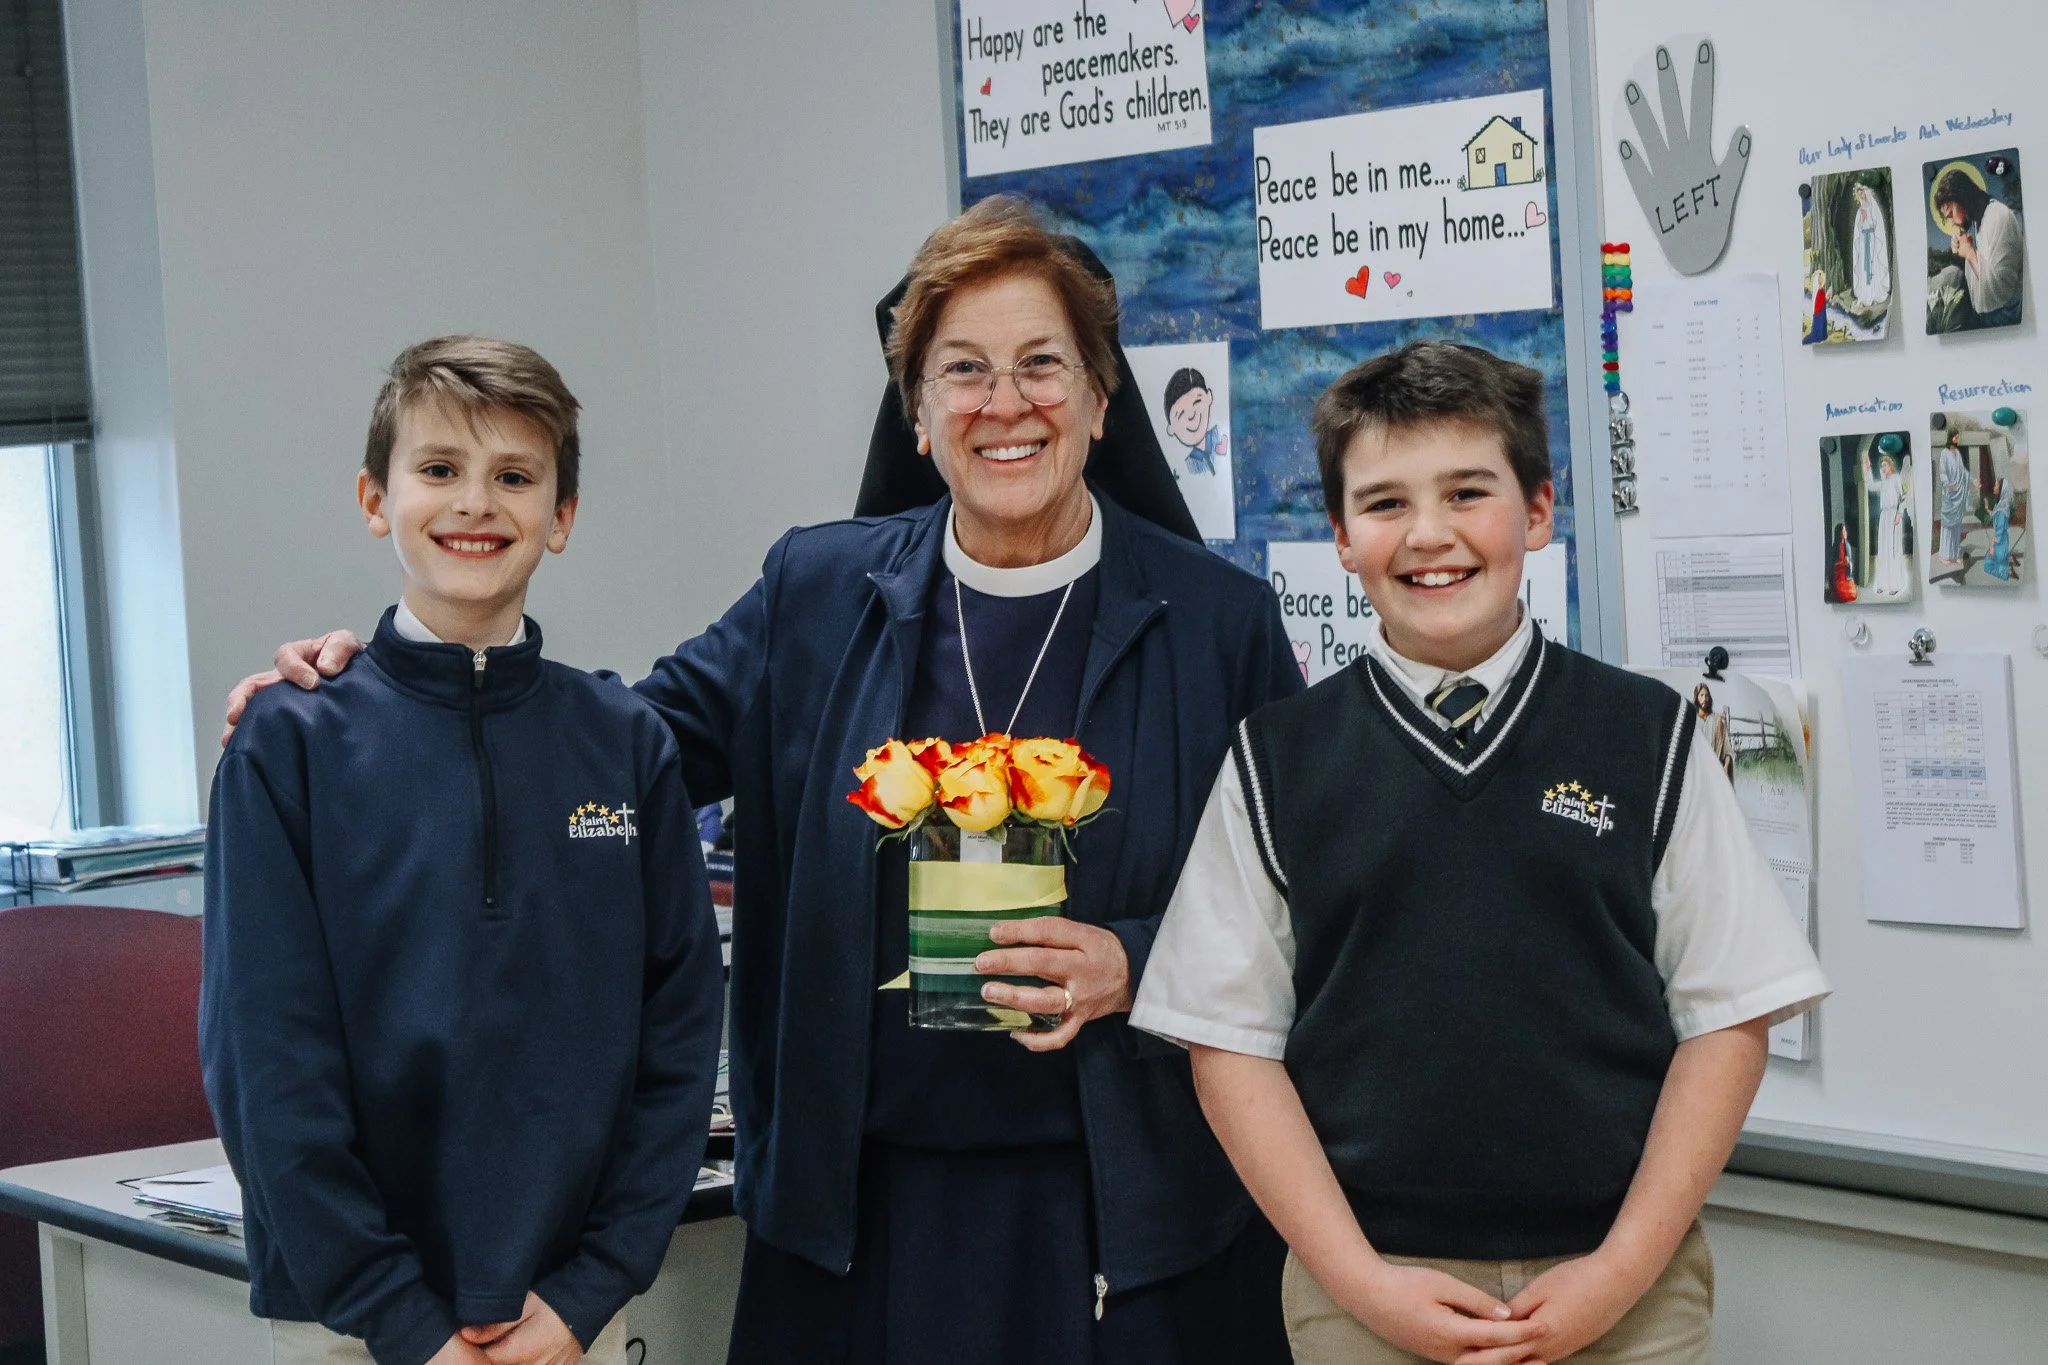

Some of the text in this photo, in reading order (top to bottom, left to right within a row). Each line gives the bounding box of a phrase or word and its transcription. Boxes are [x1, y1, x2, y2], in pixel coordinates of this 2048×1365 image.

[967, 0, 1107, 63] Happy are the
[1042, 32, 1178, 95] peacemakers.
[969, 75, 1207, 148] They are God's children.
[1157, 122, 1171, 133] MT
[1919, 108, 2012, 140] Ash Wednesday
[1799, 147, 1821, 165] Our
[1828, 136, 1852, 159] Lady
[1855, 134, 1867, 151] of
[1255, 151, 1451, 205] Peace be in me...
[1655, 174, 1721, 235] LEFT
[1258, 197, 1525, 263] Peace be in my home...
[1938, 379, 2032, 405] Resurrection
[1272, 571, 1373, 618] Peace be
[579, 816, 608, 826] Saint
[1557, 793, 1587, 811] Saint
